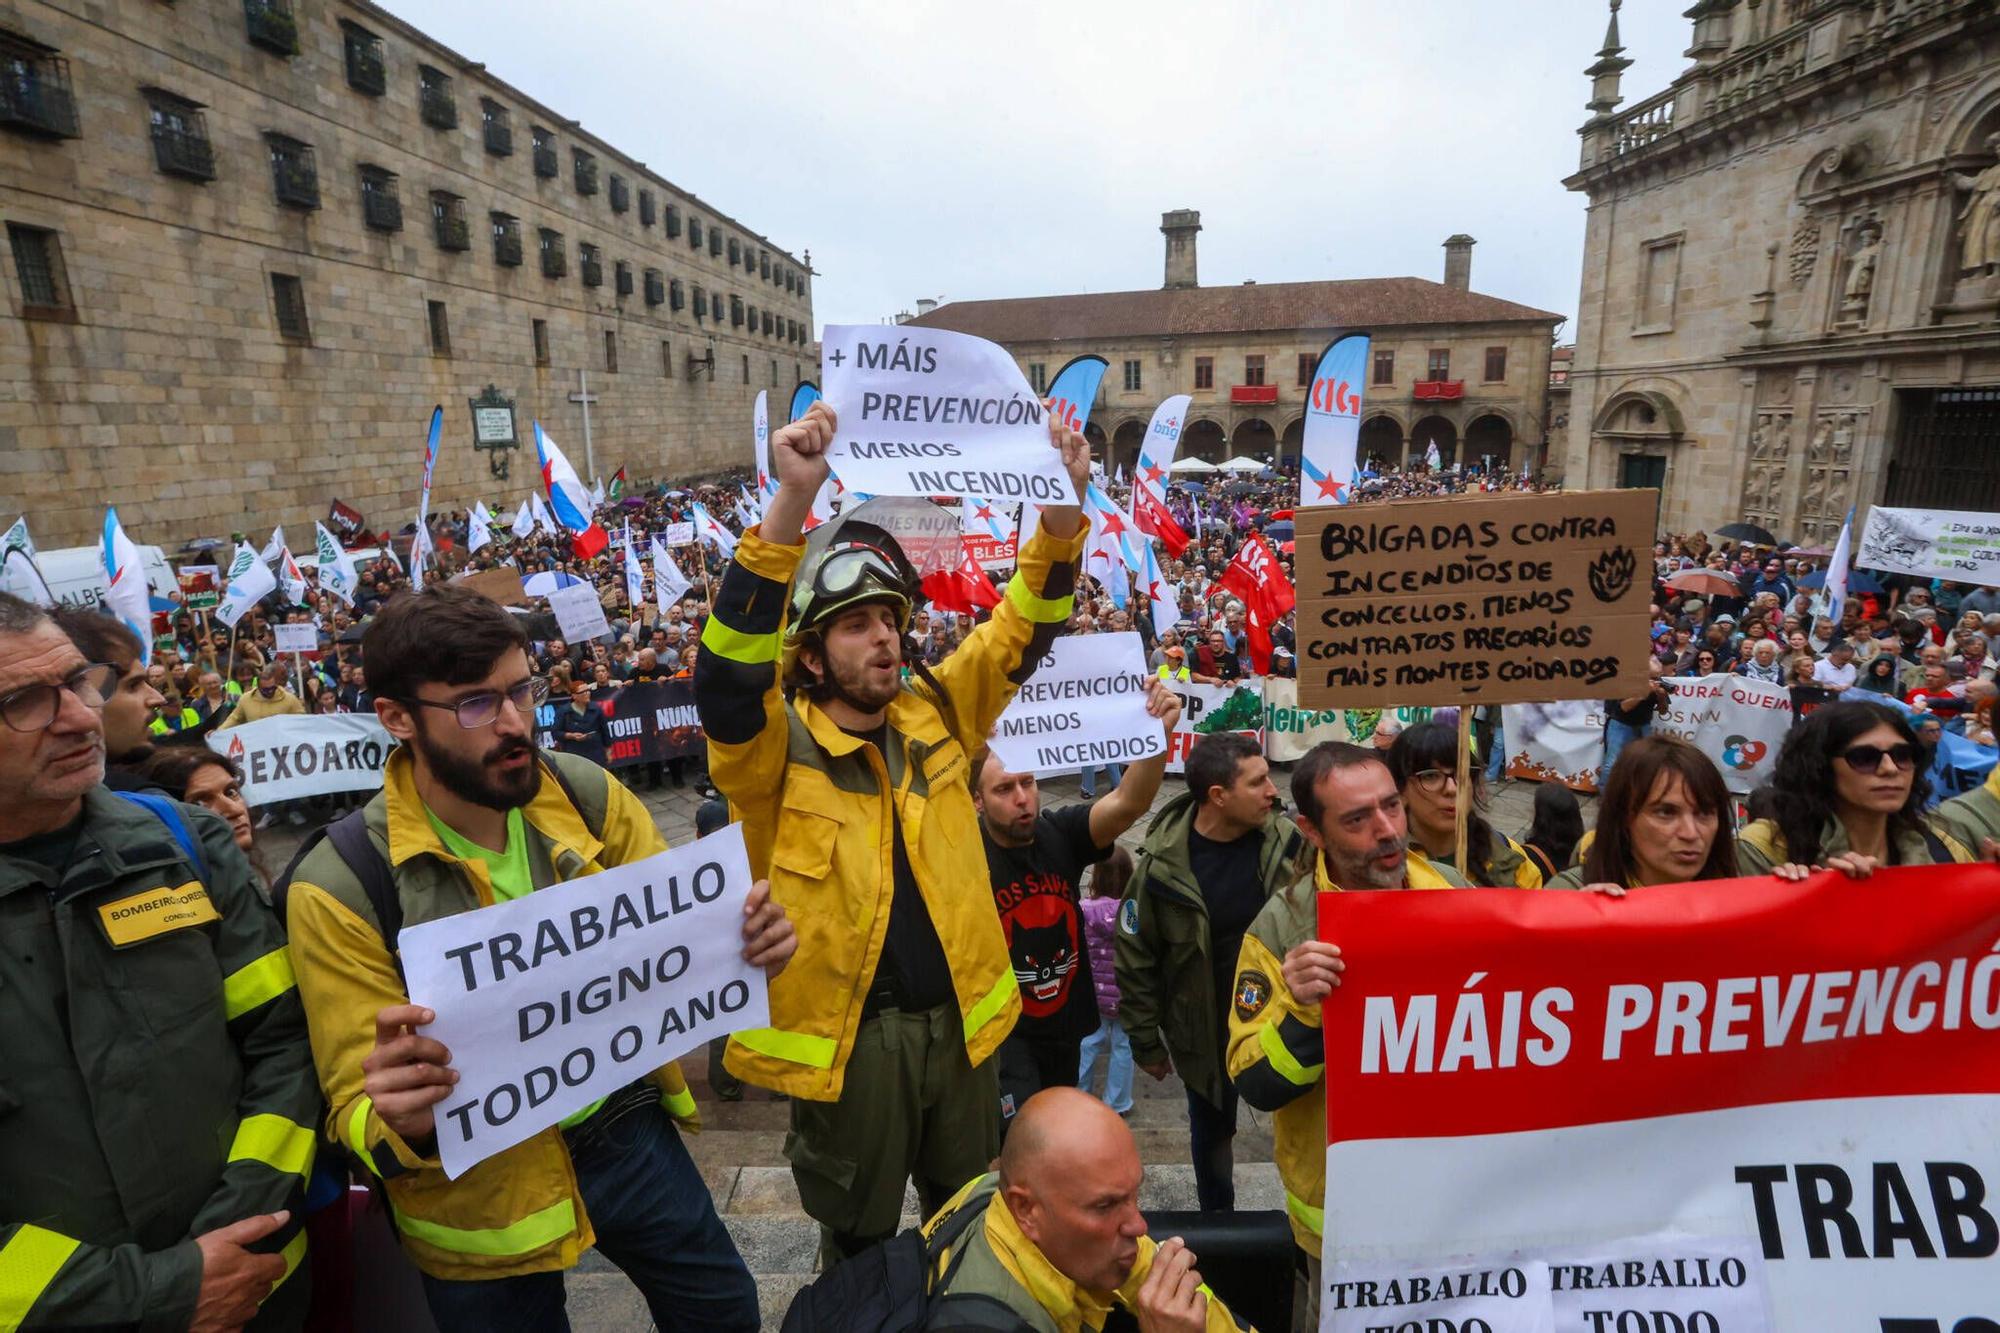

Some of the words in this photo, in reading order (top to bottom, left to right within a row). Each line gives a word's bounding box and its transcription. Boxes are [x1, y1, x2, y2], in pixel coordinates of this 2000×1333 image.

[857, 338, 937, 374] MÁIS
[862, 392, 1041, 425] PREVENCIÓN
[1312, 377, 1360, 415] CIG
[1154, 420, 1179, 441] bng
[850, 442, 962, 460] MENOS
[909, 471, 1065, 501] INCENDIOS
[1320, 521, 1499, 561] BRIGADAS
[1511, 517, 1616, 546] CONTRA
[1518, 561, 1552, 581] DE
[1483, 588, 1574, 618] MENOS
[1307, 630, 1455, 660] CONTRATOS
[1021, 671, 1145, 703] REVENCIÓN
[1396, 660, 1489, 686] MONTES
[1003, 712, 1081, 737] MENOS
[1037, 735, 1159, 766] INCENDIOS
[445, 861, 725, 991] TRABALLO
[518, 945, 691, 1042] DIGNO
[1361, 972, 1574, 1074] MÁIS
[446, 1047, 595, 1142] TODO
[609, 1025, 643, 1063] O
[657, 979, 750, 1045] ANO
[1734, 1161, 2000, 1260] TRAB
[1331, 1267, 1527, 1310] TRABALLO
[1549, 1257, 1747, 1292] TRABALLO
